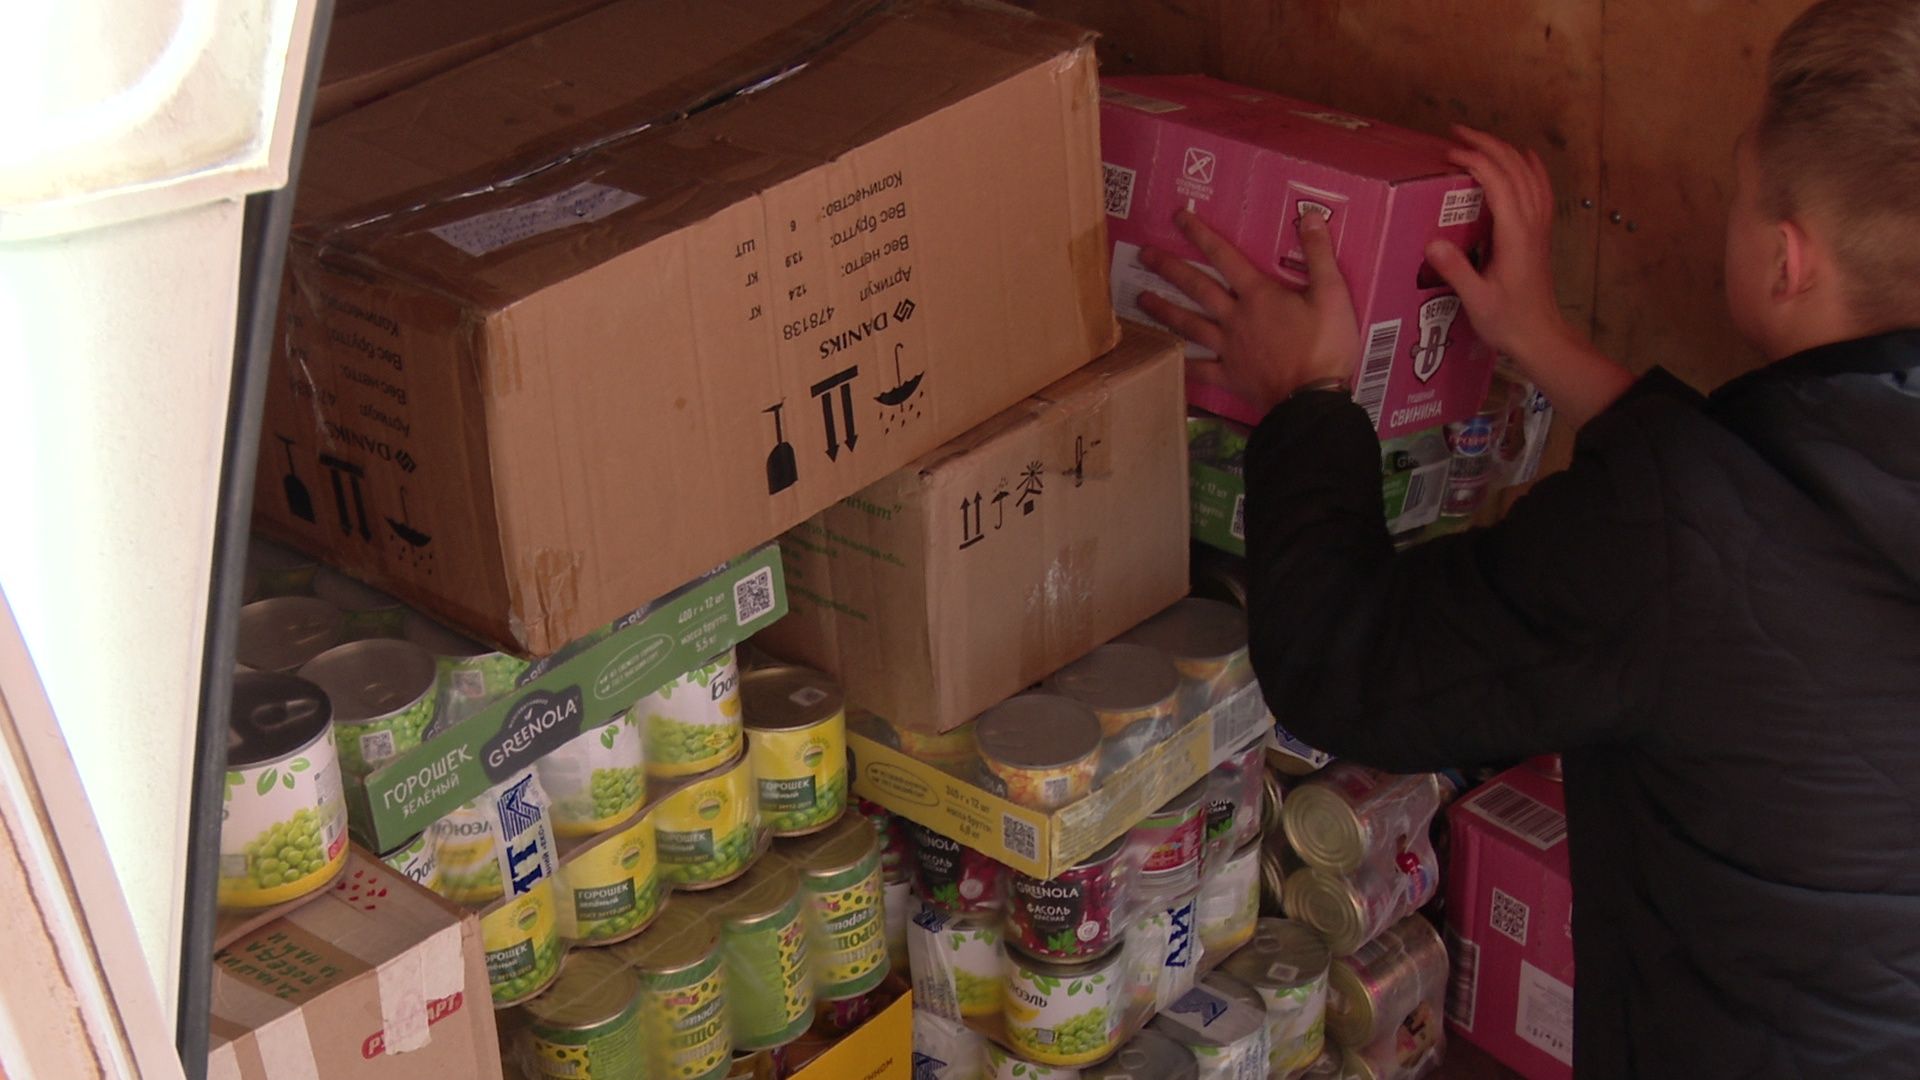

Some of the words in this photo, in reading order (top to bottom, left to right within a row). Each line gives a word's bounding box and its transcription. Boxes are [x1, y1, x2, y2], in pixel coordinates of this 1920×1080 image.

[790, 219, 797, 232] 6
[879, 201, 906, 223] Вес
[883, 234, 910, 256] Вес
[859, 265, 912, 302] Артикул
[782, 304, 835, 341] 478138
[819, 311, 889, 360] DANIKS
[1389, 400, 1443, 429] СВИНИНА
[488, 697, 579, 768] GREENOLA
[383, 743, 474, 810] ГОРОШЕК
[578, 882, 629, 900] ГОРОШЕК
[1016, 881, 1080, 899] GREENOLA
